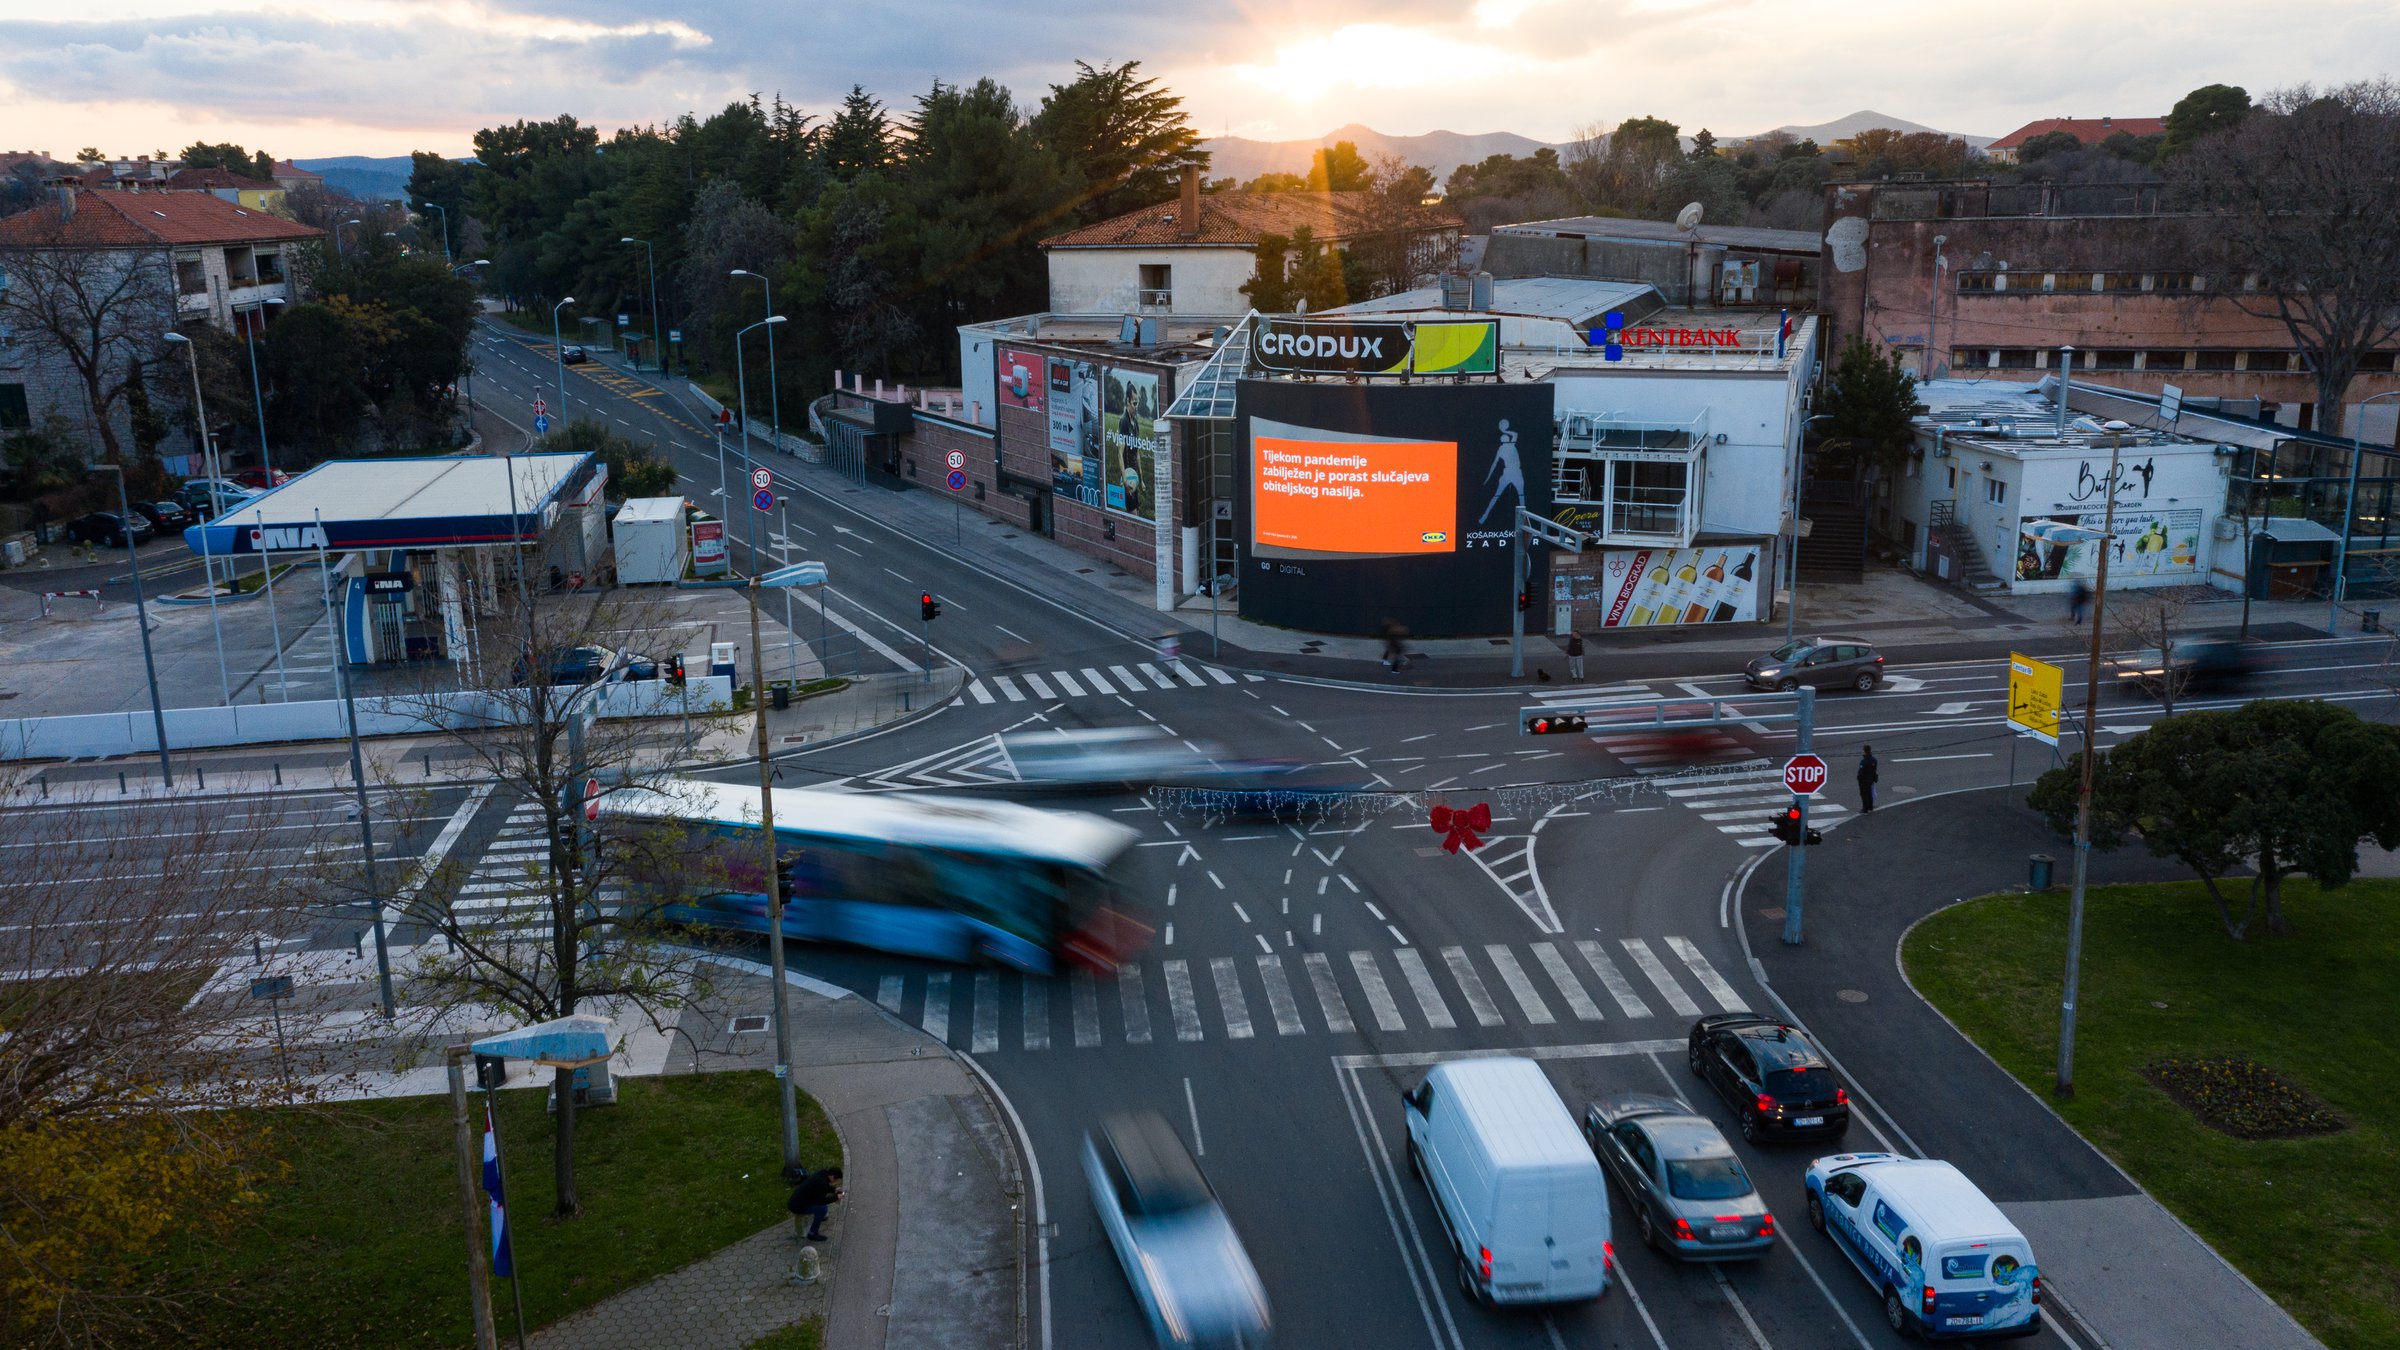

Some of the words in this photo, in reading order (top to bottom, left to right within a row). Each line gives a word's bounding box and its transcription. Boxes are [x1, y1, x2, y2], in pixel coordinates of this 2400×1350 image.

[1261, 333, 1383, 358] CRODUX
[1620, 328, 1741, 347] KENTBANK
[1053, 420, 1062, 431] 300
[950, 455, 962, 466] 50
[1263, 450, 1301, 463] Tijekom
[1304, 454, 1367, 469] pandemije
[756, 473, 768, 485] 50
[1263, 466, 1312, 479] zabilježen
[1314, 469, 1326, 483] je
[1328, 470, 1368, 483] porast
[1371, 470, 1429, 485] slučajeva
[2069, 460, 2136, 501] Butler
[1263, 481, 1319, 498] obiteljskog
[1321, 486, 1364, 499] nasilja.
[1552, 507, 1599, 528] Opera
[2125, 517, 2140, 526] you
[2140, 514, 2155, 523] taste
[250, 527, 329, 549] INA
[1279, 564, 1305, 576] DIGITAL
[374, 580, 403, 589] INA
[1609, 600, 1625, 621] VINA
[1620, 555, 1647, 599] BIOGRAD
[1787, 766, 1824, 783] STOP
